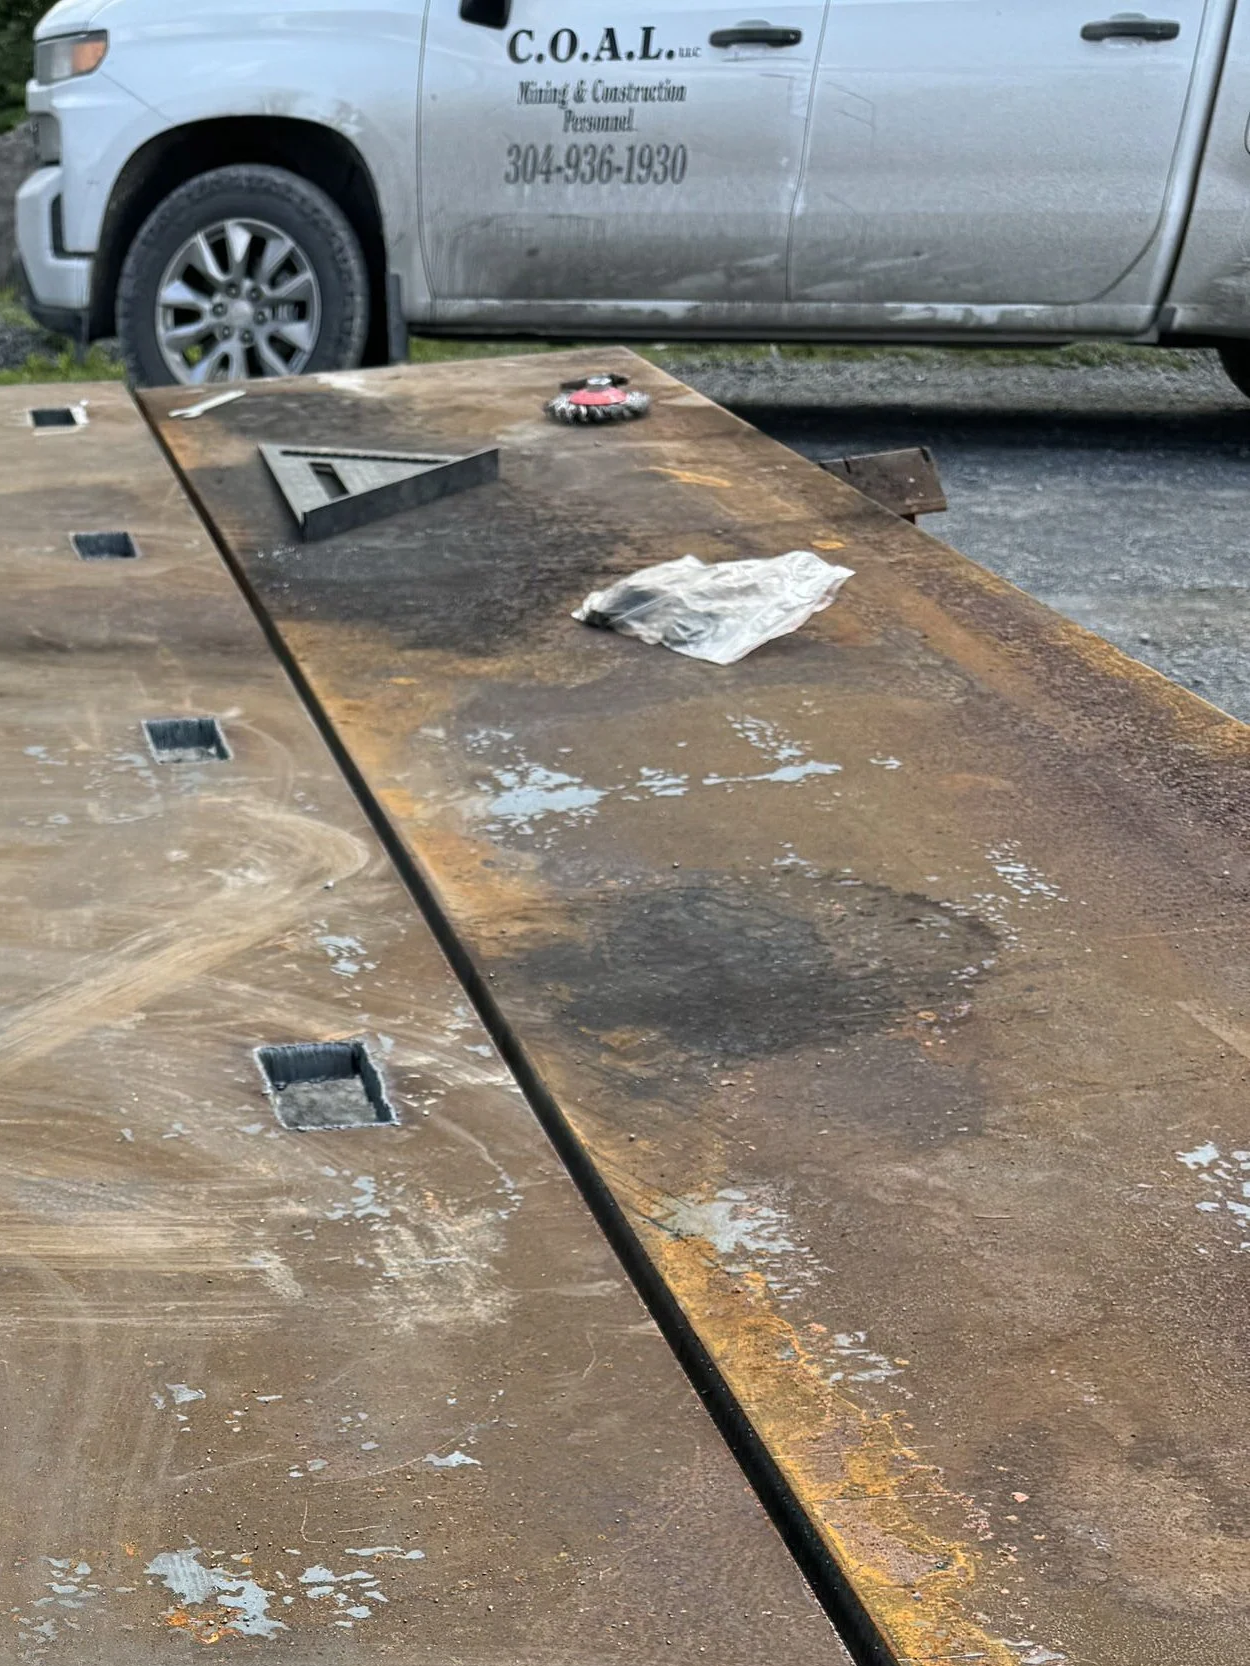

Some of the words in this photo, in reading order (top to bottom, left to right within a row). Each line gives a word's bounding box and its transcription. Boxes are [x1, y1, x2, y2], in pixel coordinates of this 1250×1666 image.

[507, 26, 676, 64] C.O.A.L.
[517, 80, 569, 109] Mining
[573, 79, 587, 104] &
[591, 78, 687, 104] Construction
[562, 107, 636, 132] Personnel
[504, 142, 688, 185] 304-936-1930
